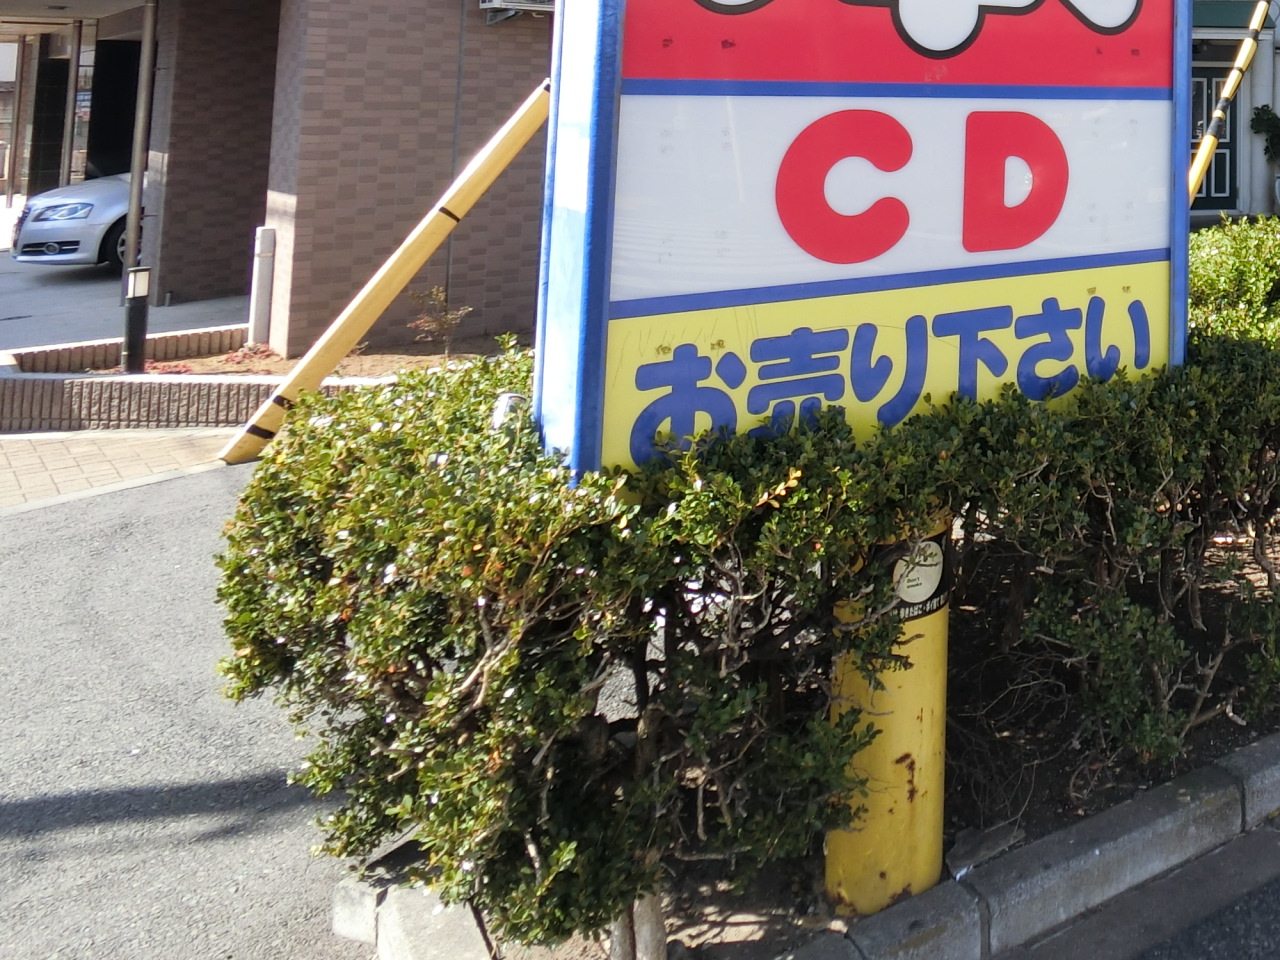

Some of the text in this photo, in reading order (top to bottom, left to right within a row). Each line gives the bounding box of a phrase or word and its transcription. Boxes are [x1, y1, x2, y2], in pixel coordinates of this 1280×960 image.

[774, 108, 1070, 265] CD
[629, 295, 1150, 468] お売り下さい
